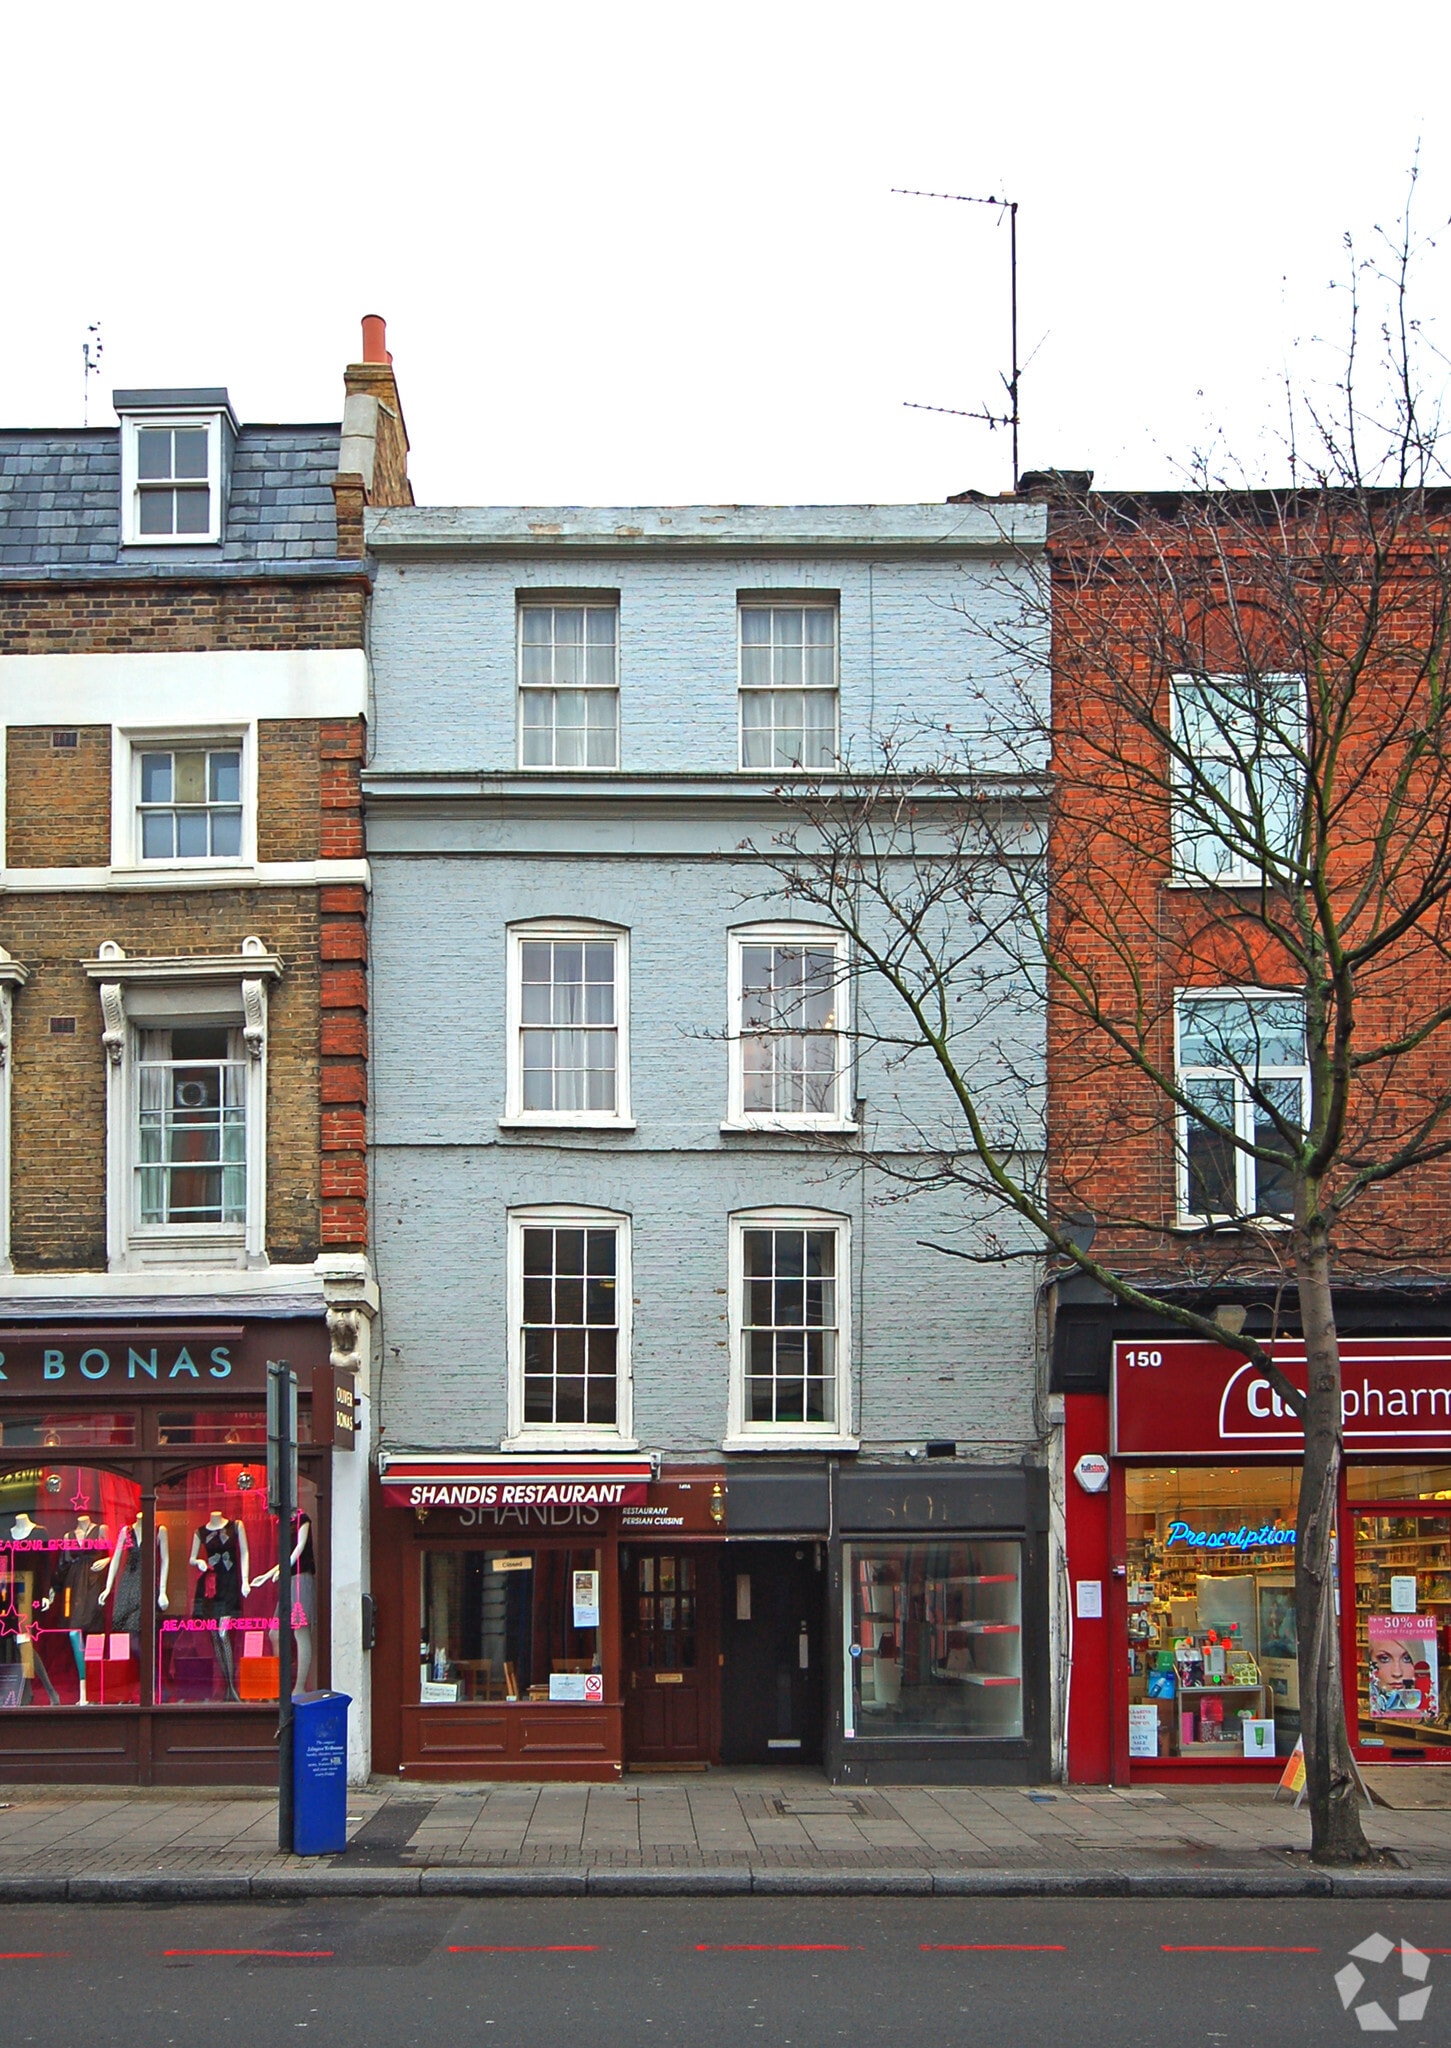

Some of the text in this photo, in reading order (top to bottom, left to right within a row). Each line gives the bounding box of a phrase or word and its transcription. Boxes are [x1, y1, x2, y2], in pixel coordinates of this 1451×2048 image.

[44, 1347, 232, 1379] BONAS
[1125, 1351, 1162, 1367] 150
[336, 1386, 353, 1407] OLIVER
[336, 1410, 353, 1431] BONAS
[410, 1485, 625, 1504] SHANDIS RESTAURANT
[622, 1507, 669, 1515] RESTAURANT
[622, 1517, 684, 1525] PERSIAN CUISINE
[1384, 1616, 1413, 1628] 50%
[1417, 1615, 1434, 1628] off
